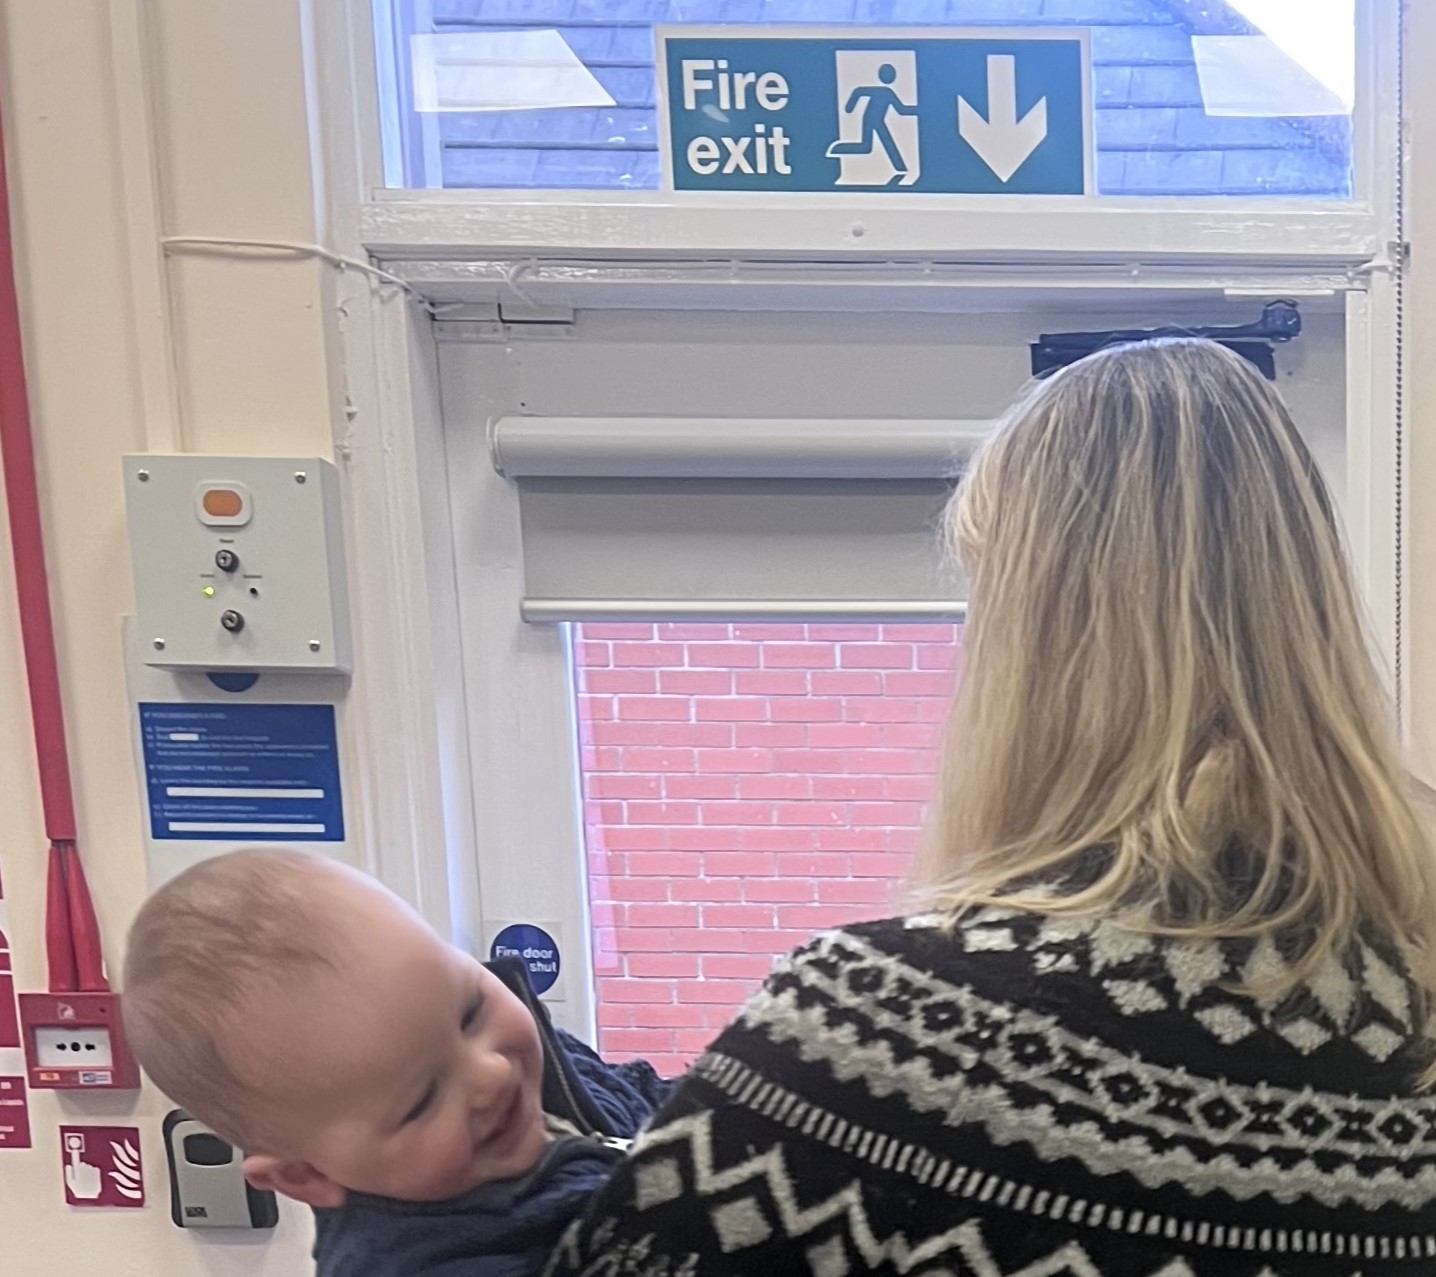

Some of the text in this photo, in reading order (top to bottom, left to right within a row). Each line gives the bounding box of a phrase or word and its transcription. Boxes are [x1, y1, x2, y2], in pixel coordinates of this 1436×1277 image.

[682, 59, 790, 111] Fire
[687, 123, 792, 175] exit
[496, 946, 553, 958] Fire door
[529, 961, 557, 972] shut
